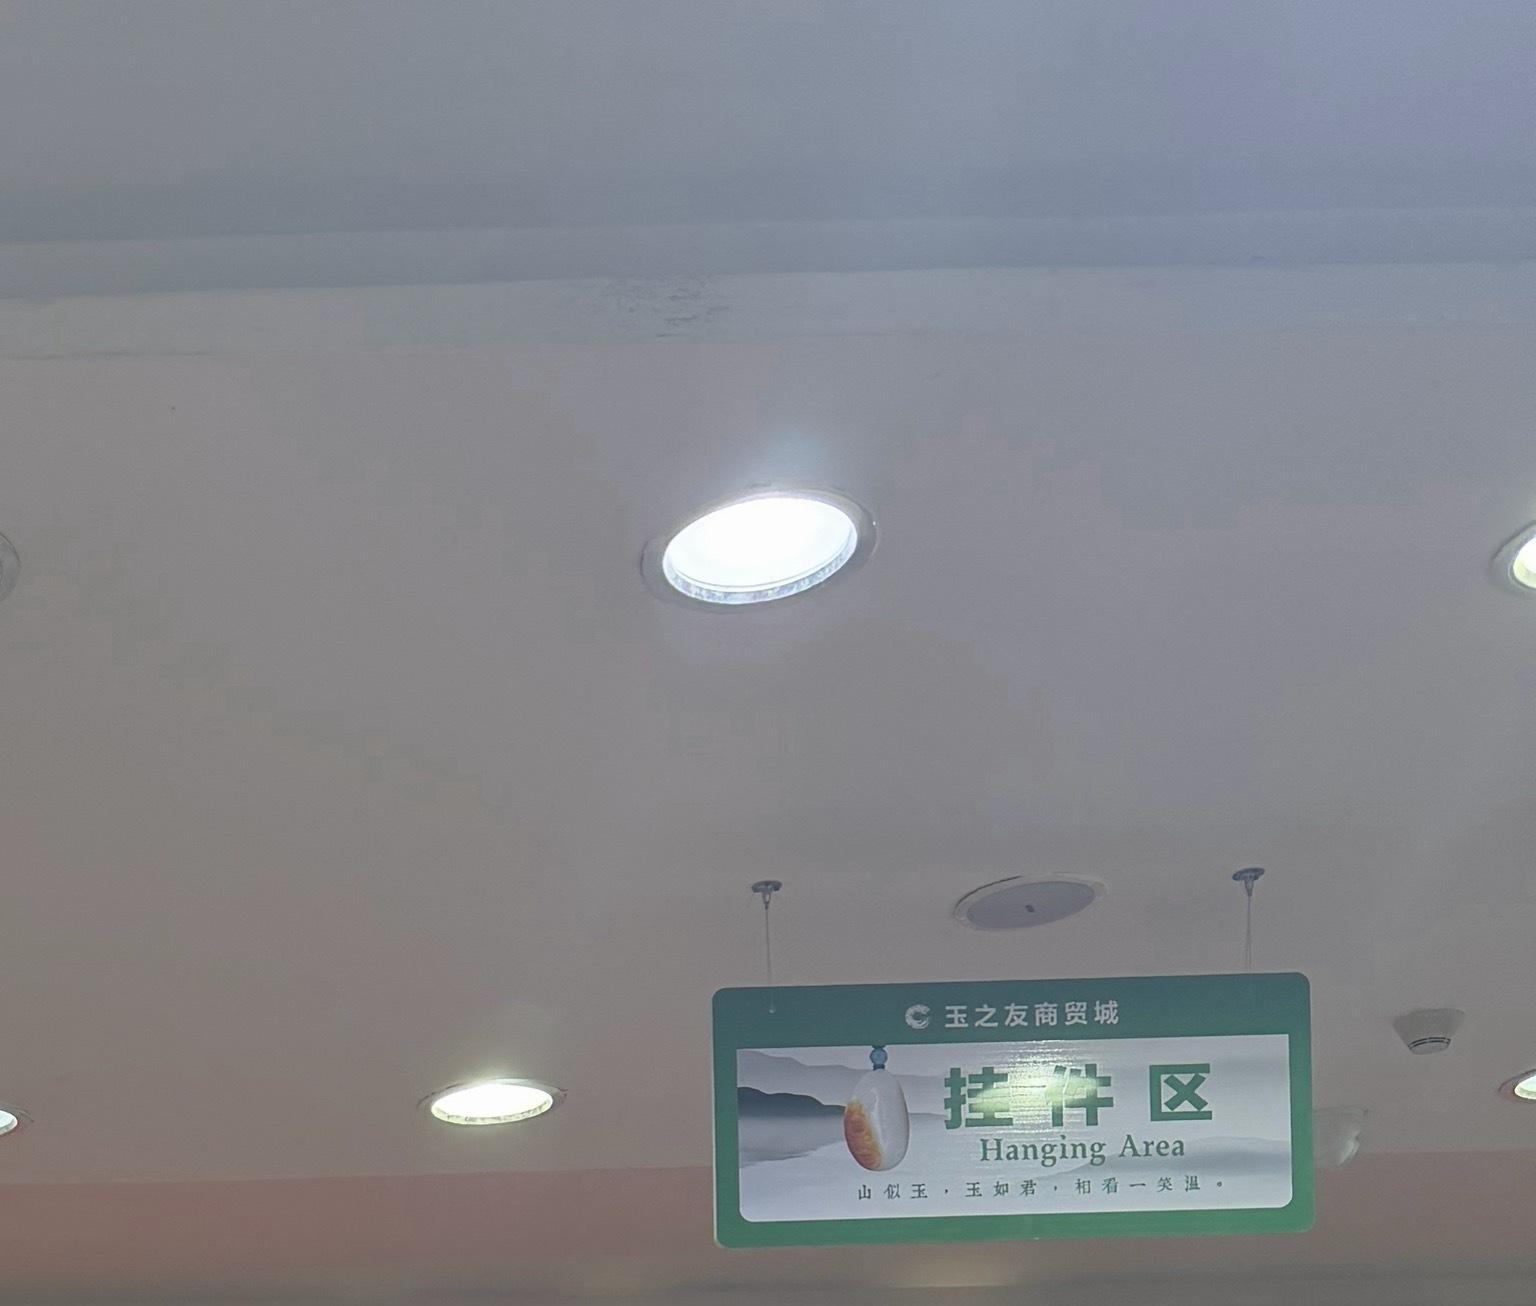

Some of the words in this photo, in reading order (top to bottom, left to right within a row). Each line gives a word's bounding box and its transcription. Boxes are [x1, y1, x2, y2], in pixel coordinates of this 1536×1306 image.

[945, 1000, 1119, 1028] 玉之友商贸城
[944, 1063, 1212, 1130] 挂件区
[980, 1135, 1106, 1167] Hanging
[1118, 1134, 1185, 1158] Area
